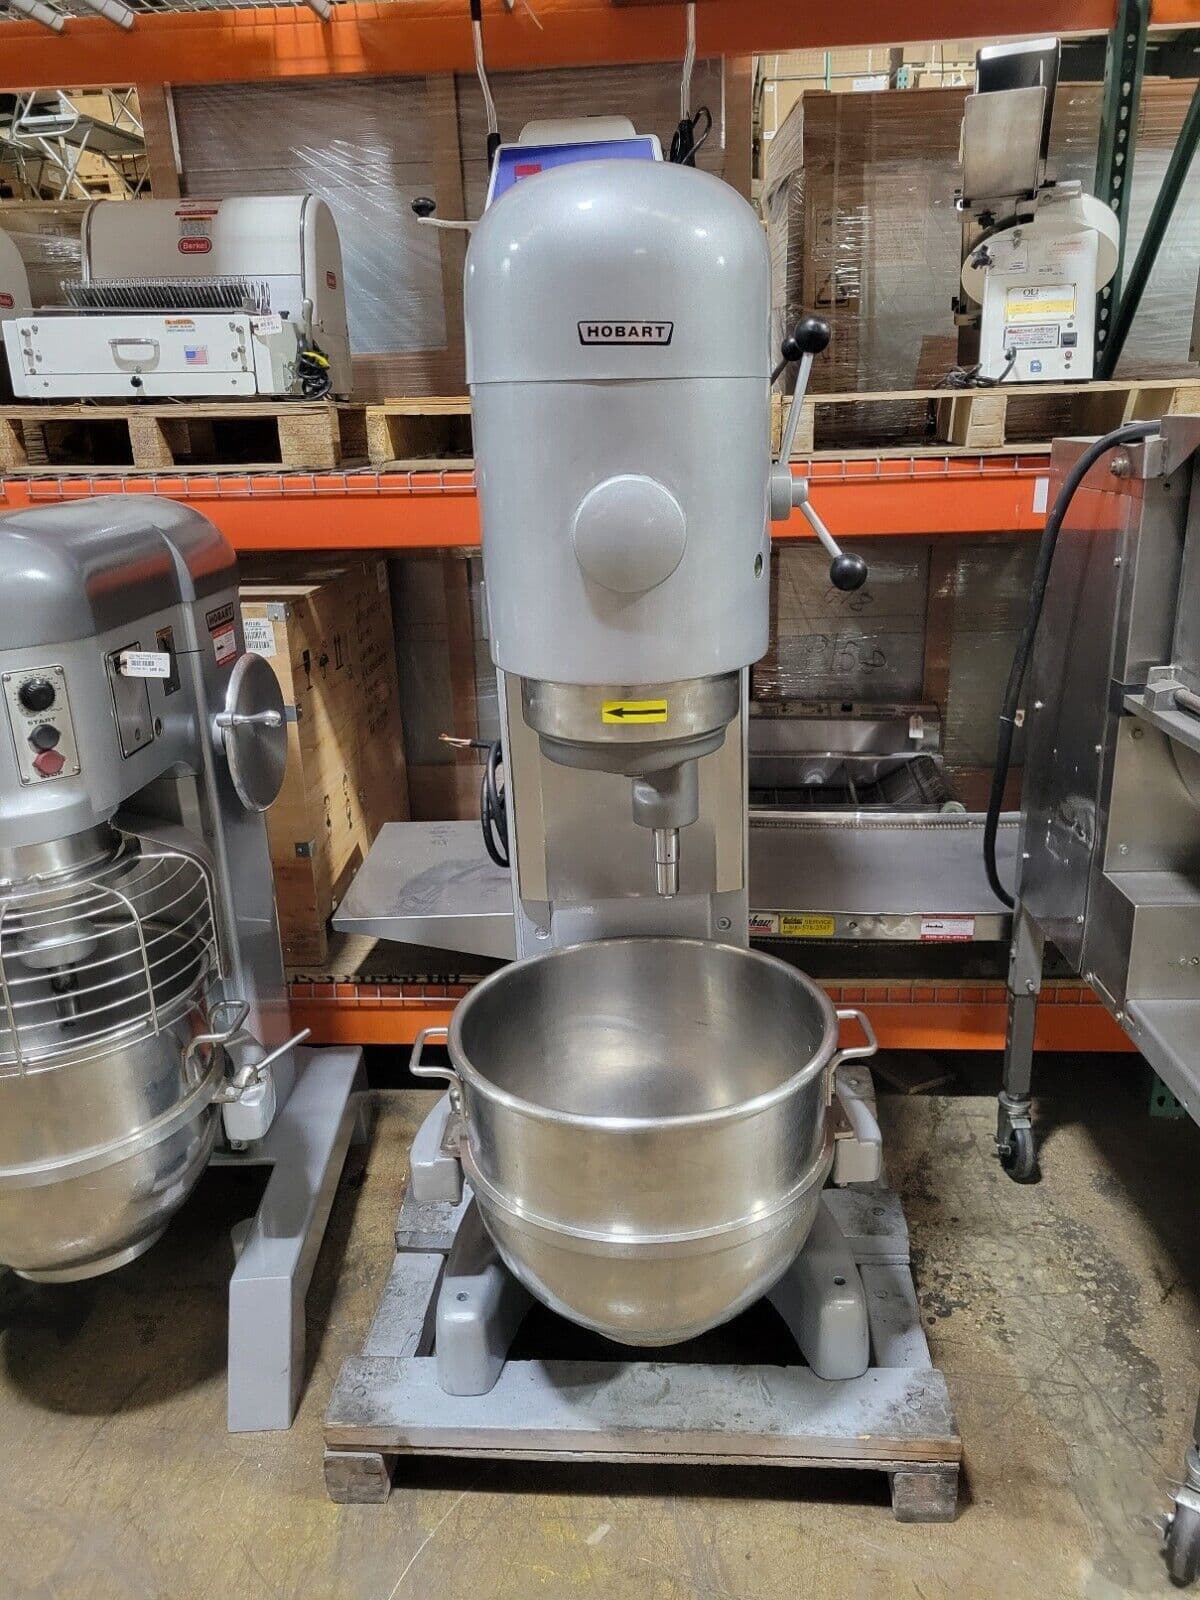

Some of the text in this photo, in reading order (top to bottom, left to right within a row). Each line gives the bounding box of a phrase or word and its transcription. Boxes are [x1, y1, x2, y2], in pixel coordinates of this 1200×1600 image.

[182, 242, 208, 250] Berkel
[587, 326, 665, 338] HOBART
[208, 605, 233, 626] HOBART
[27, 717, 56, 725] START
